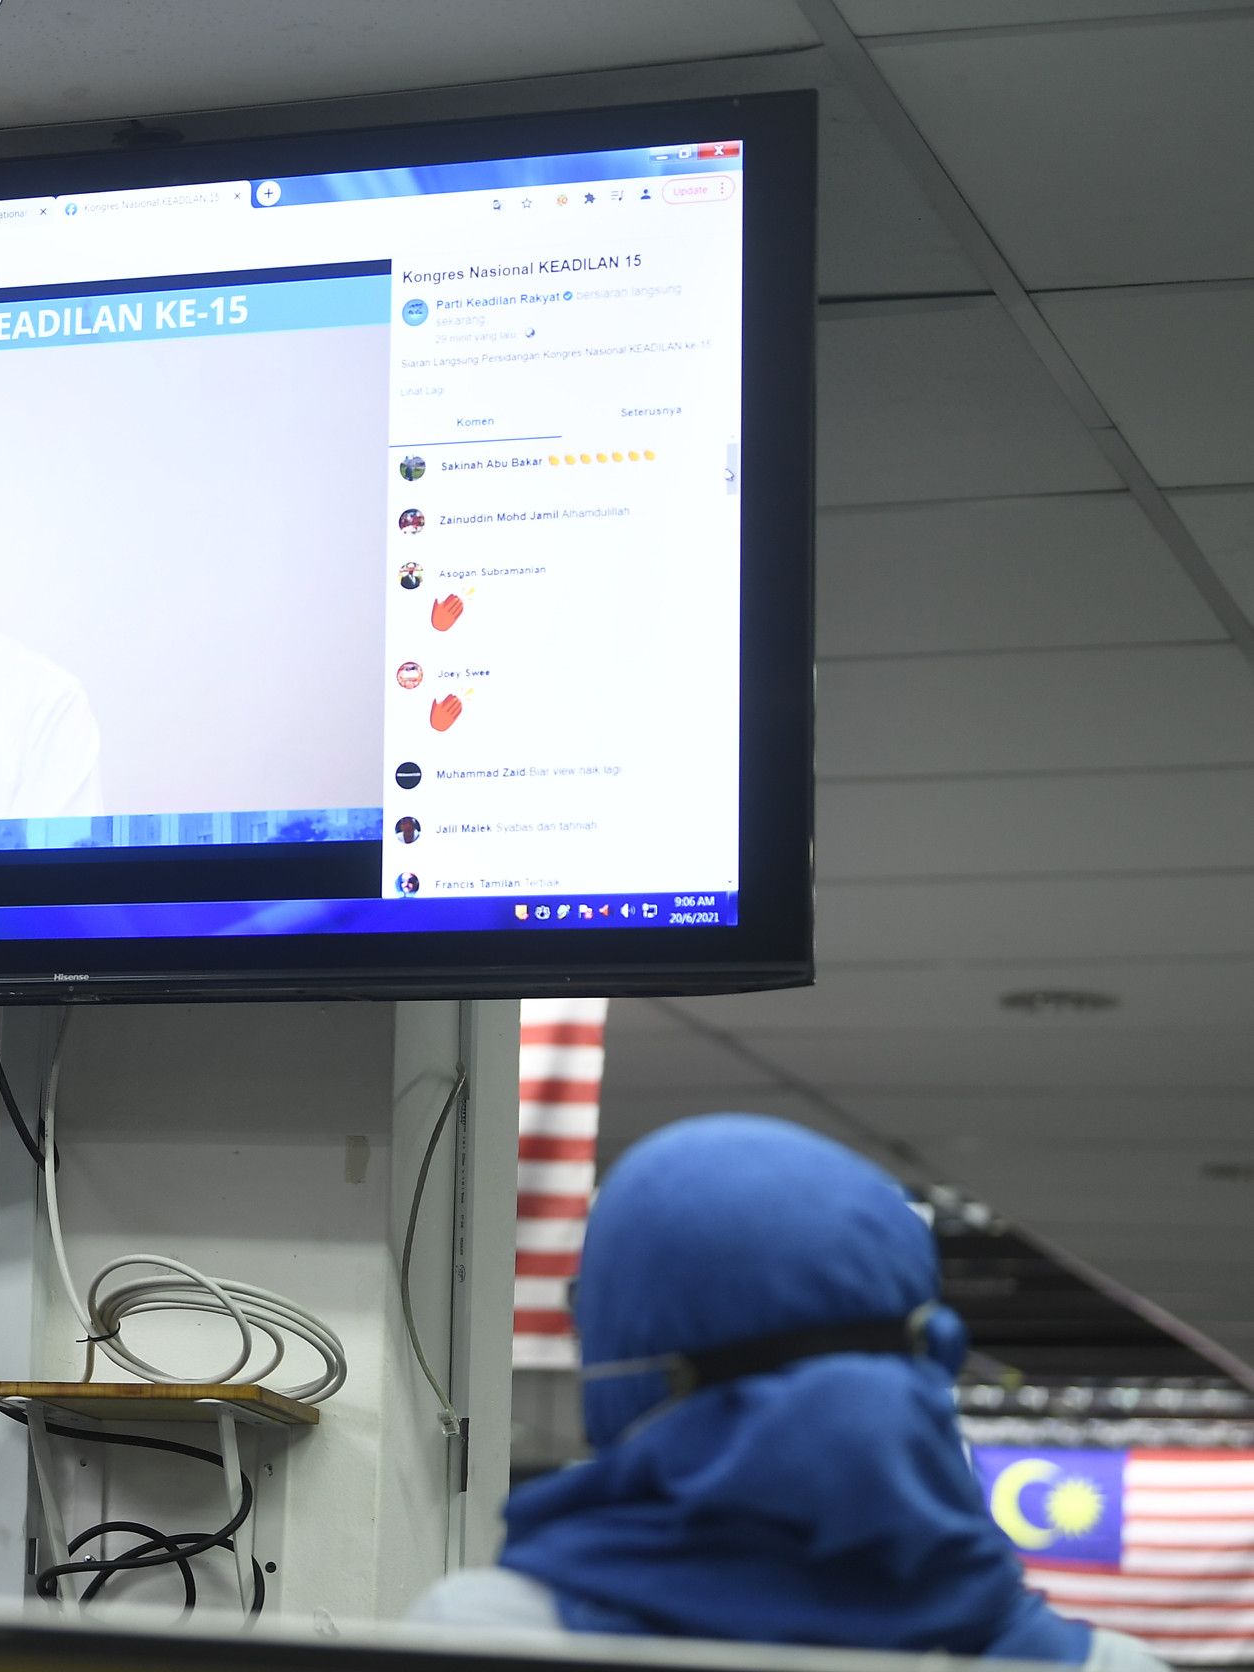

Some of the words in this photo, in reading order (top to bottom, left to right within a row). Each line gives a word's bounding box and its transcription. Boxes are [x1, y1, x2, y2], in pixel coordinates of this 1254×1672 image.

[403, 270, 464, 285] Kongres
[470, 262, 533, 278] Nasional
[539, 256, 619, 274] KEADILAN
[625, 254, 642, 267] 15
[436, 299, 462, 310] Parti
[466, 296, 516, 308] Keadilan
[520, 292, 560, 305] Rakyat
[156, 295, 248, 330] KE-15
[401, 358, 431, 369] Siaran
[434, 355, 479, 368] Langsung
[544, 348, 582, 361] Kongres
[621, 406, 682, 418] Seterusnya
[456, 416, 494, 427] Komen
[441, 460, 483, 471] Sakinah
[486, 458, 507, 469] Abu
[511, 456, 543, 468] Bakar
[439, 514, 493, 525] Zainuddin
[497, 511, 526, 522] Mohd
[530, 510, 559, 521] Jamil
[439, 568, 477, 580] Asogan
[481, 565, 546, 577] Subramanian
[438, 669, 461, 680] Joey
[465, 668, 491, 678] Swee
[436, 768, 499, 779] Muhammad
[502, 767, 526, 777] Zaid
[436, 824, 457, 834] Jalil
[461, 824, 492, 833] Malek
[435, 880, 475, 889] Francis
[480, 879, 520, 888] Tamilan
[674, 896, 696, 907] 9:06
[697, 895, 715, 906] AM
[669, 911, 720, 924] 20/6/2021
[53, 973, 89, 981] Hisense
